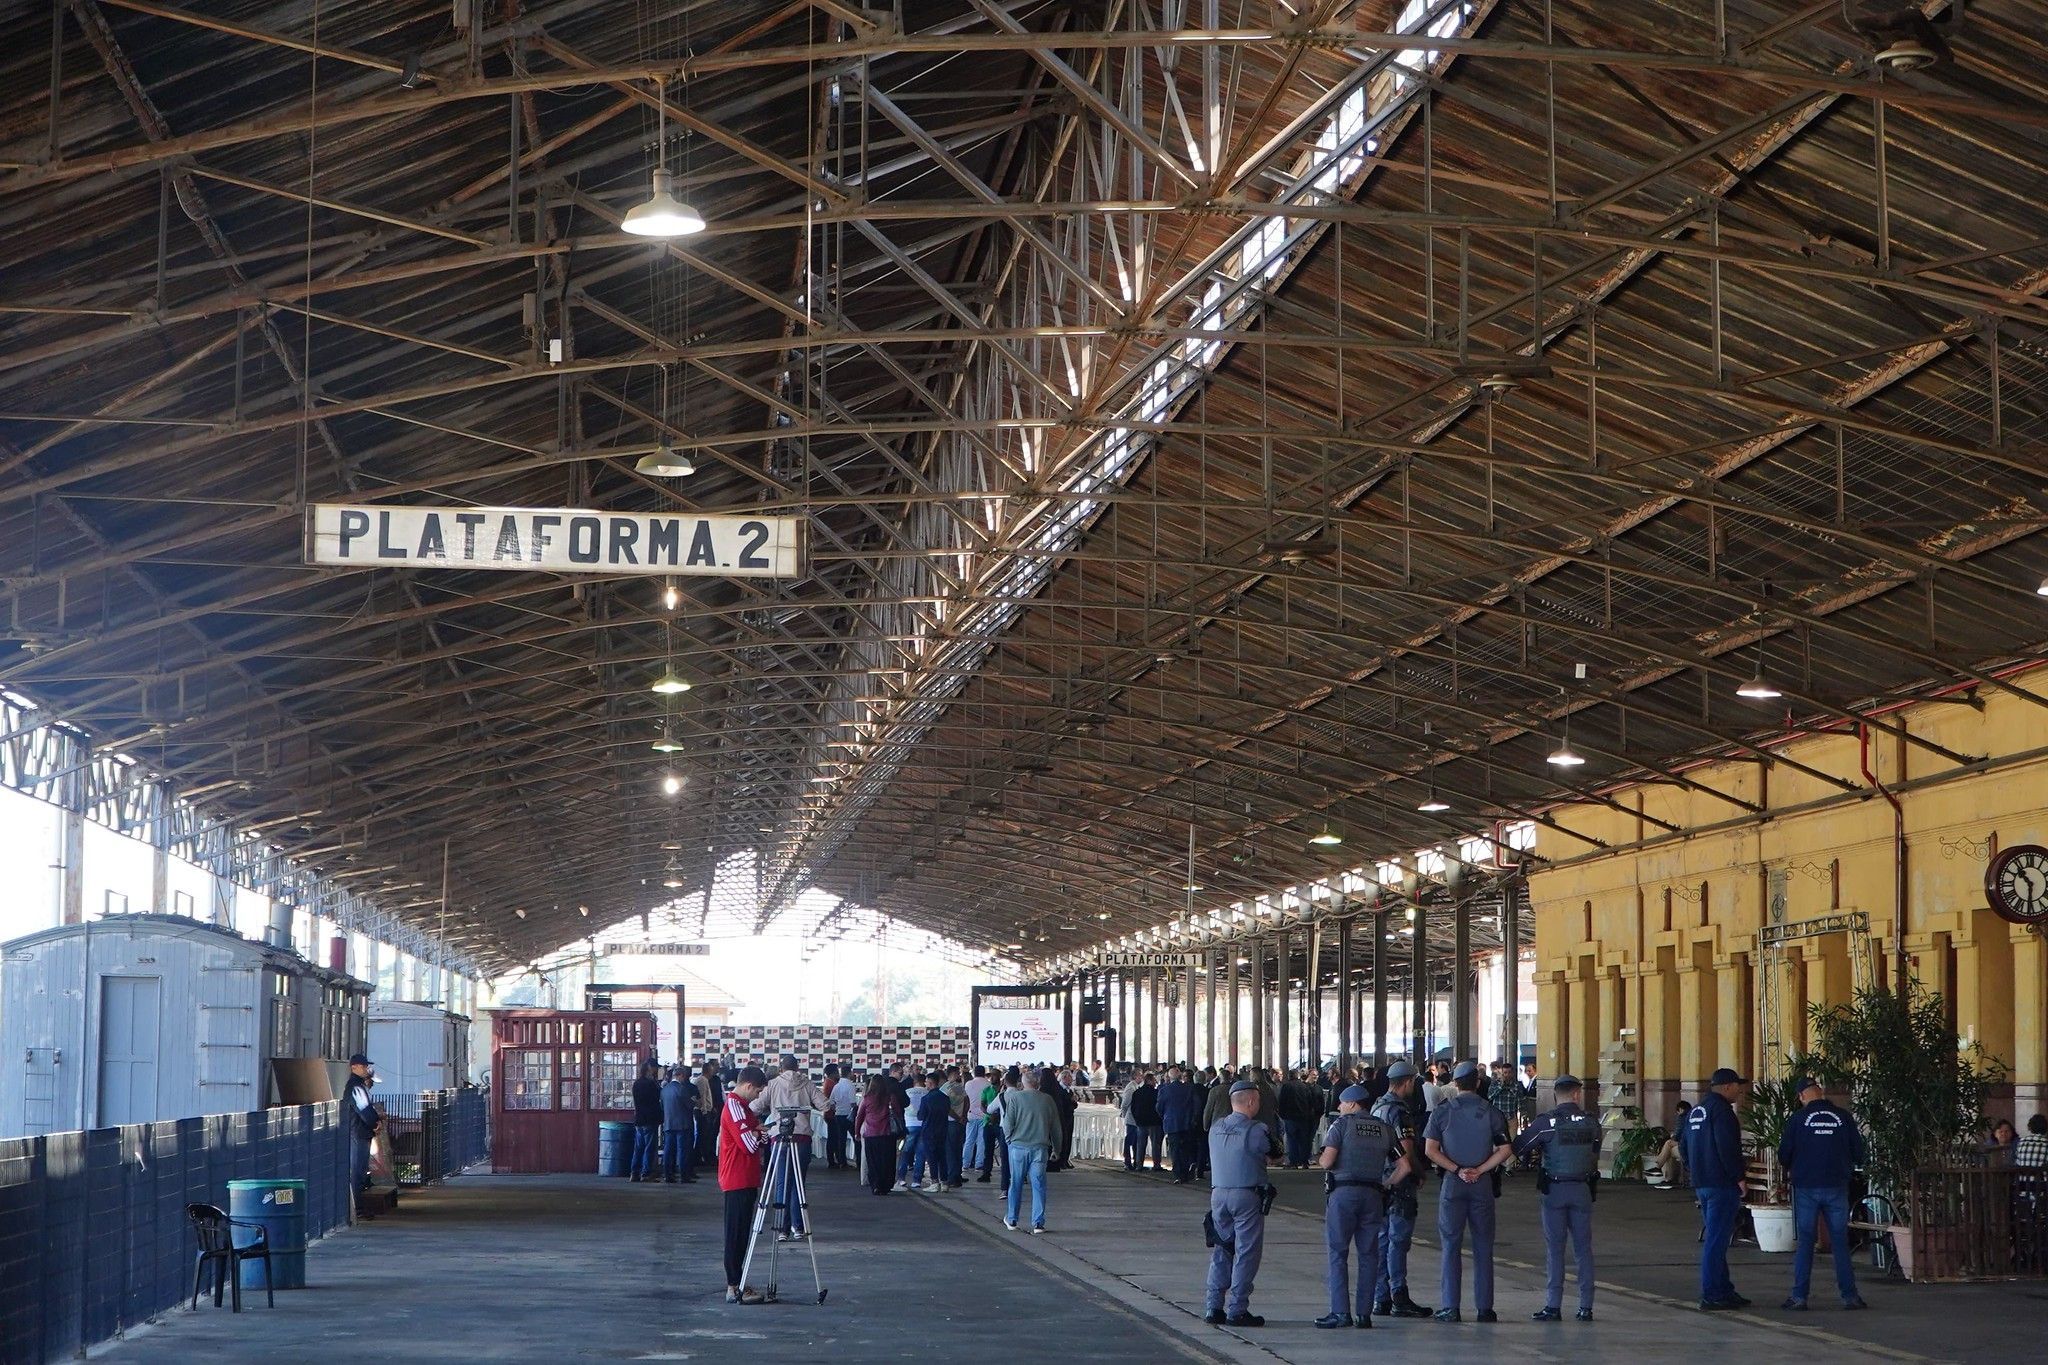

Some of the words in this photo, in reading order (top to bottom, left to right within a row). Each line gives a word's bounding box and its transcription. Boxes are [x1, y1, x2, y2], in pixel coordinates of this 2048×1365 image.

[610, 943, 691, 955] PLATAFORMA
[696, 945, 703, 955] 2
[1106, 954, 1186, 965] PLATAFORMA
[1192, 954, 1197, 965] 1
[986, 1030, 1000, 1039] SP
[1003, 1030, 1028, 1039] NOS
[986, 1041, 1035, 1050] TRILHOS
